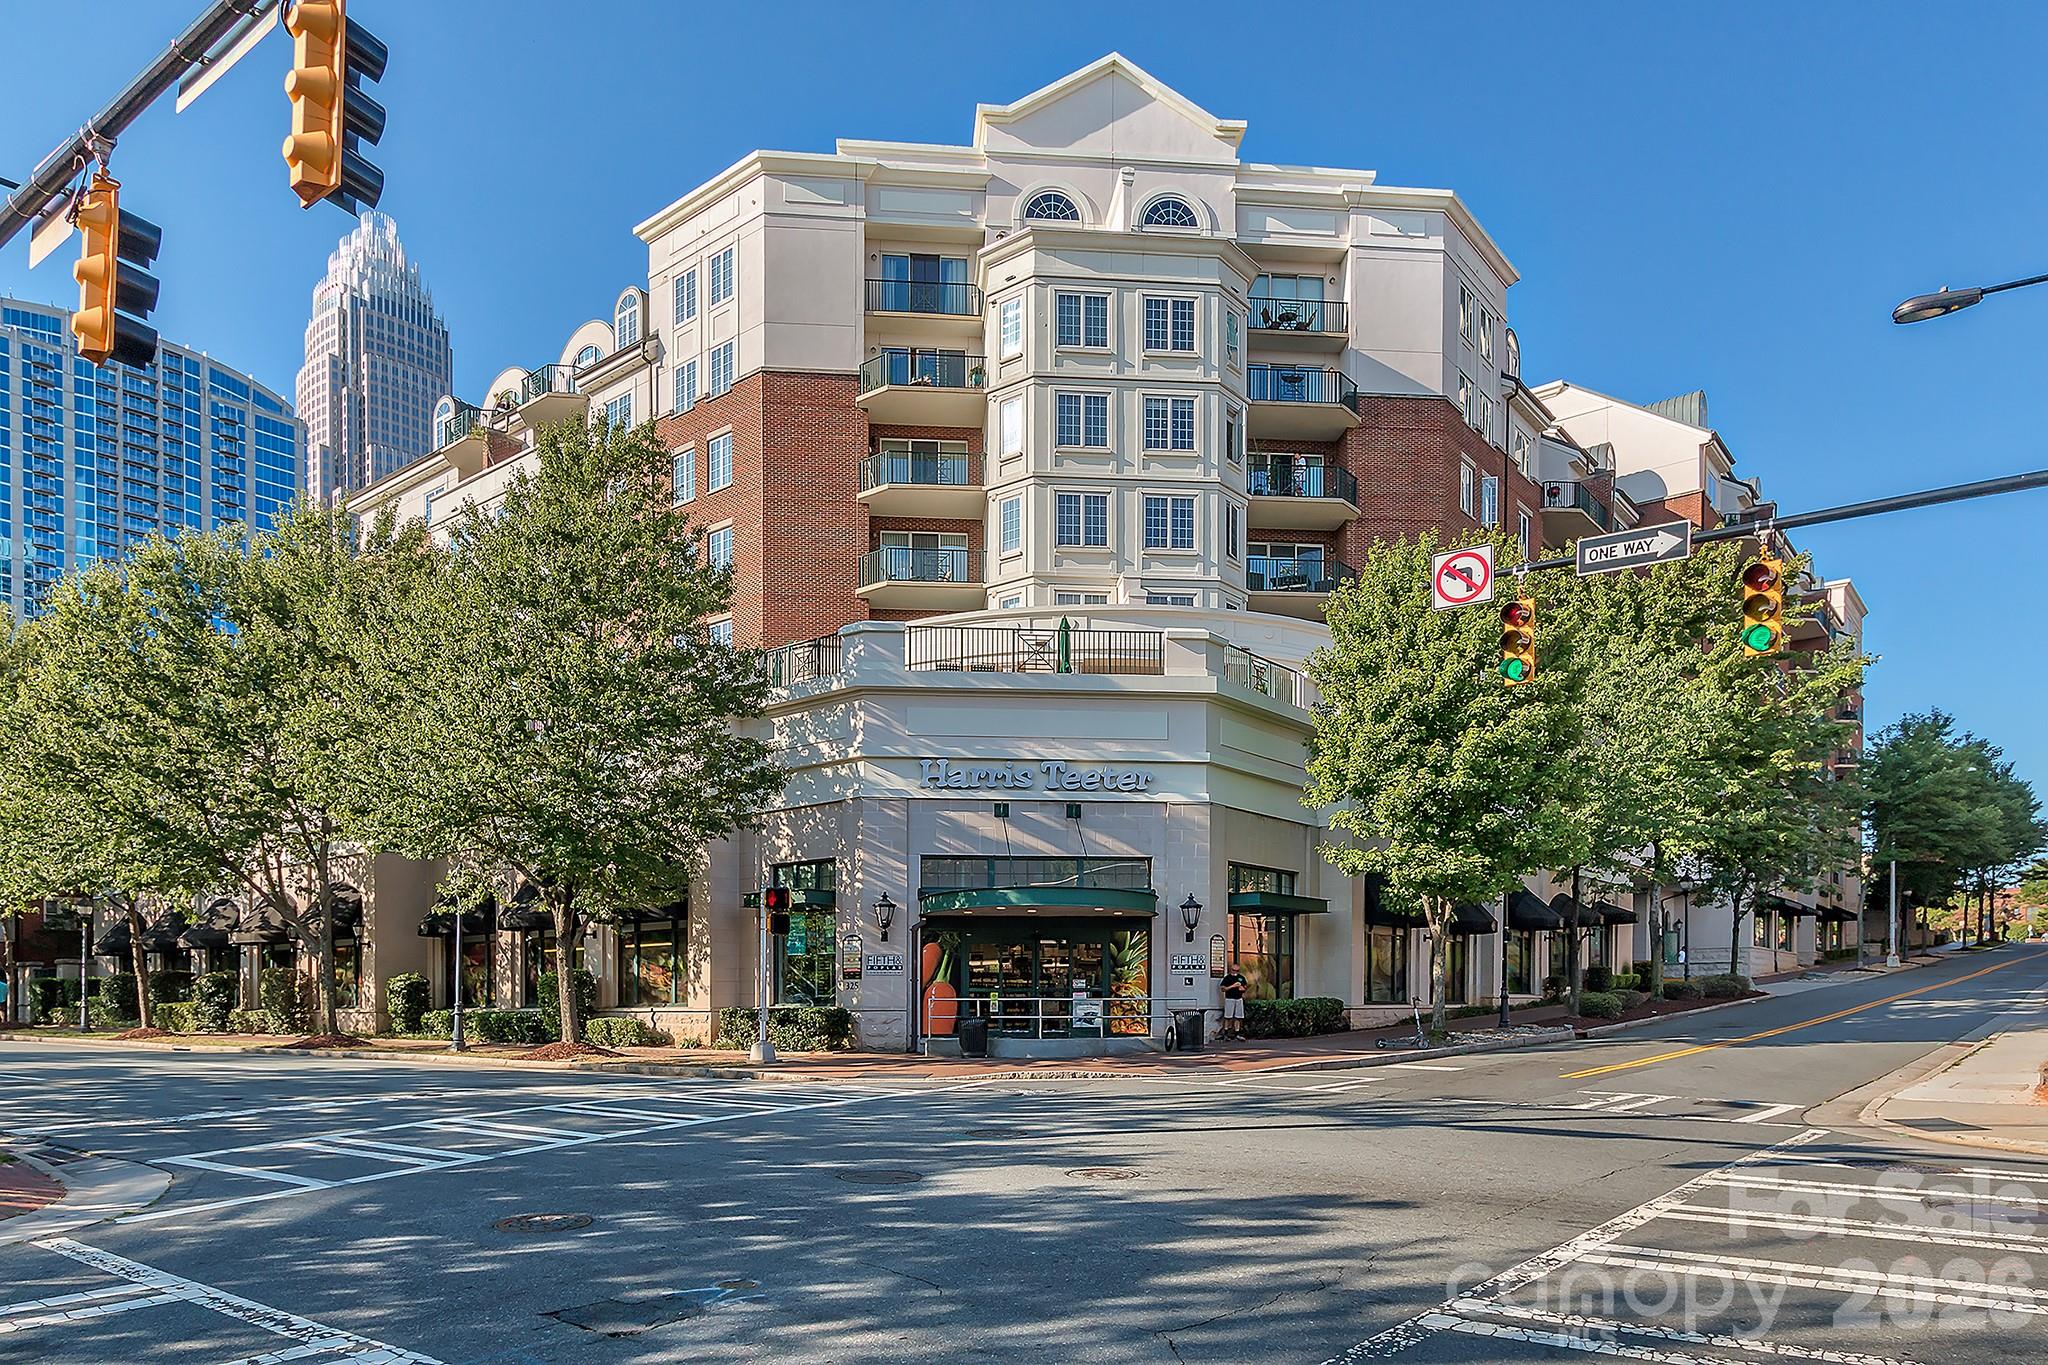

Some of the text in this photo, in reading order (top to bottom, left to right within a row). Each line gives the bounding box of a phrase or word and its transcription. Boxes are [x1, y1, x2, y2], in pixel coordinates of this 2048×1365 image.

[1589, 539, 1655, 561] ONE WAY
[919, 758, 1153, 791] Harris Teeter
[846, 982, 859, 990] 325
